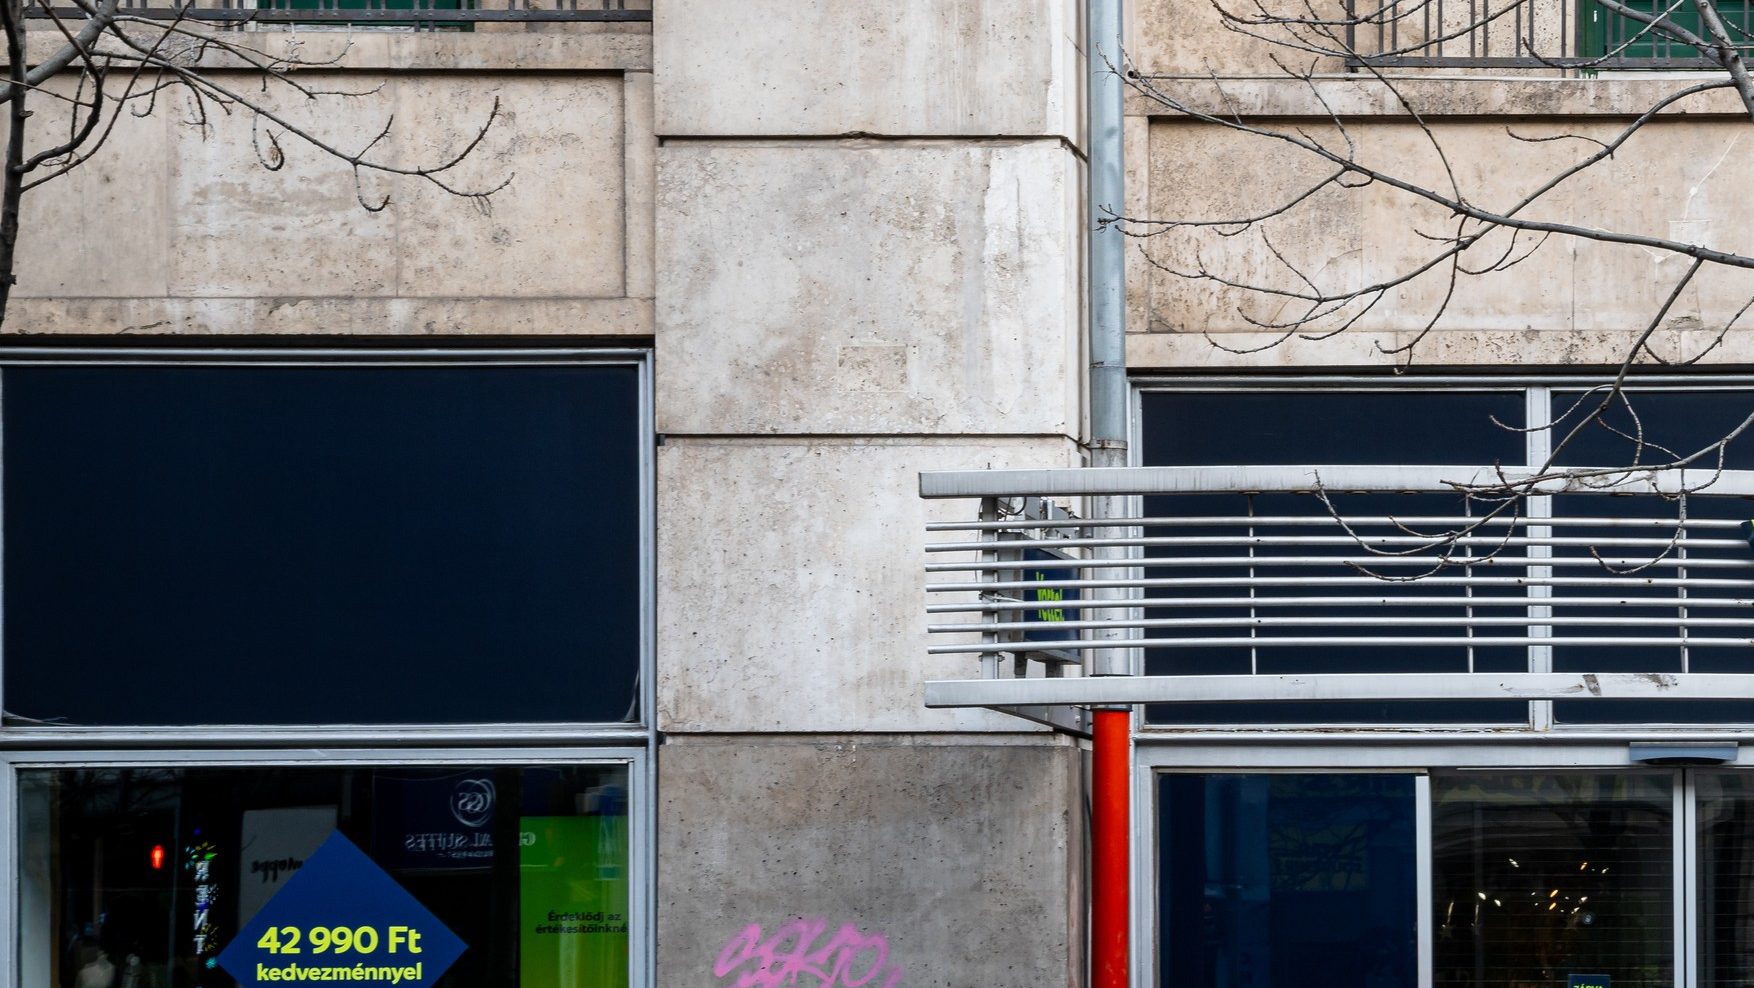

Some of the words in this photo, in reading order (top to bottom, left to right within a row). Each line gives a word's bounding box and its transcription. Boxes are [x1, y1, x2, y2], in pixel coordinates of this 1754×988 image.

[607, 913, 622, 922] az
[535, 923, 629, 934] értékesítőinkné
[257, 926, 301, 954] 42
[308, 925, 379, 954] 990
[388, 925, 423, 954] Ft
[256, 962, 423, 985] kedvezménnyel
